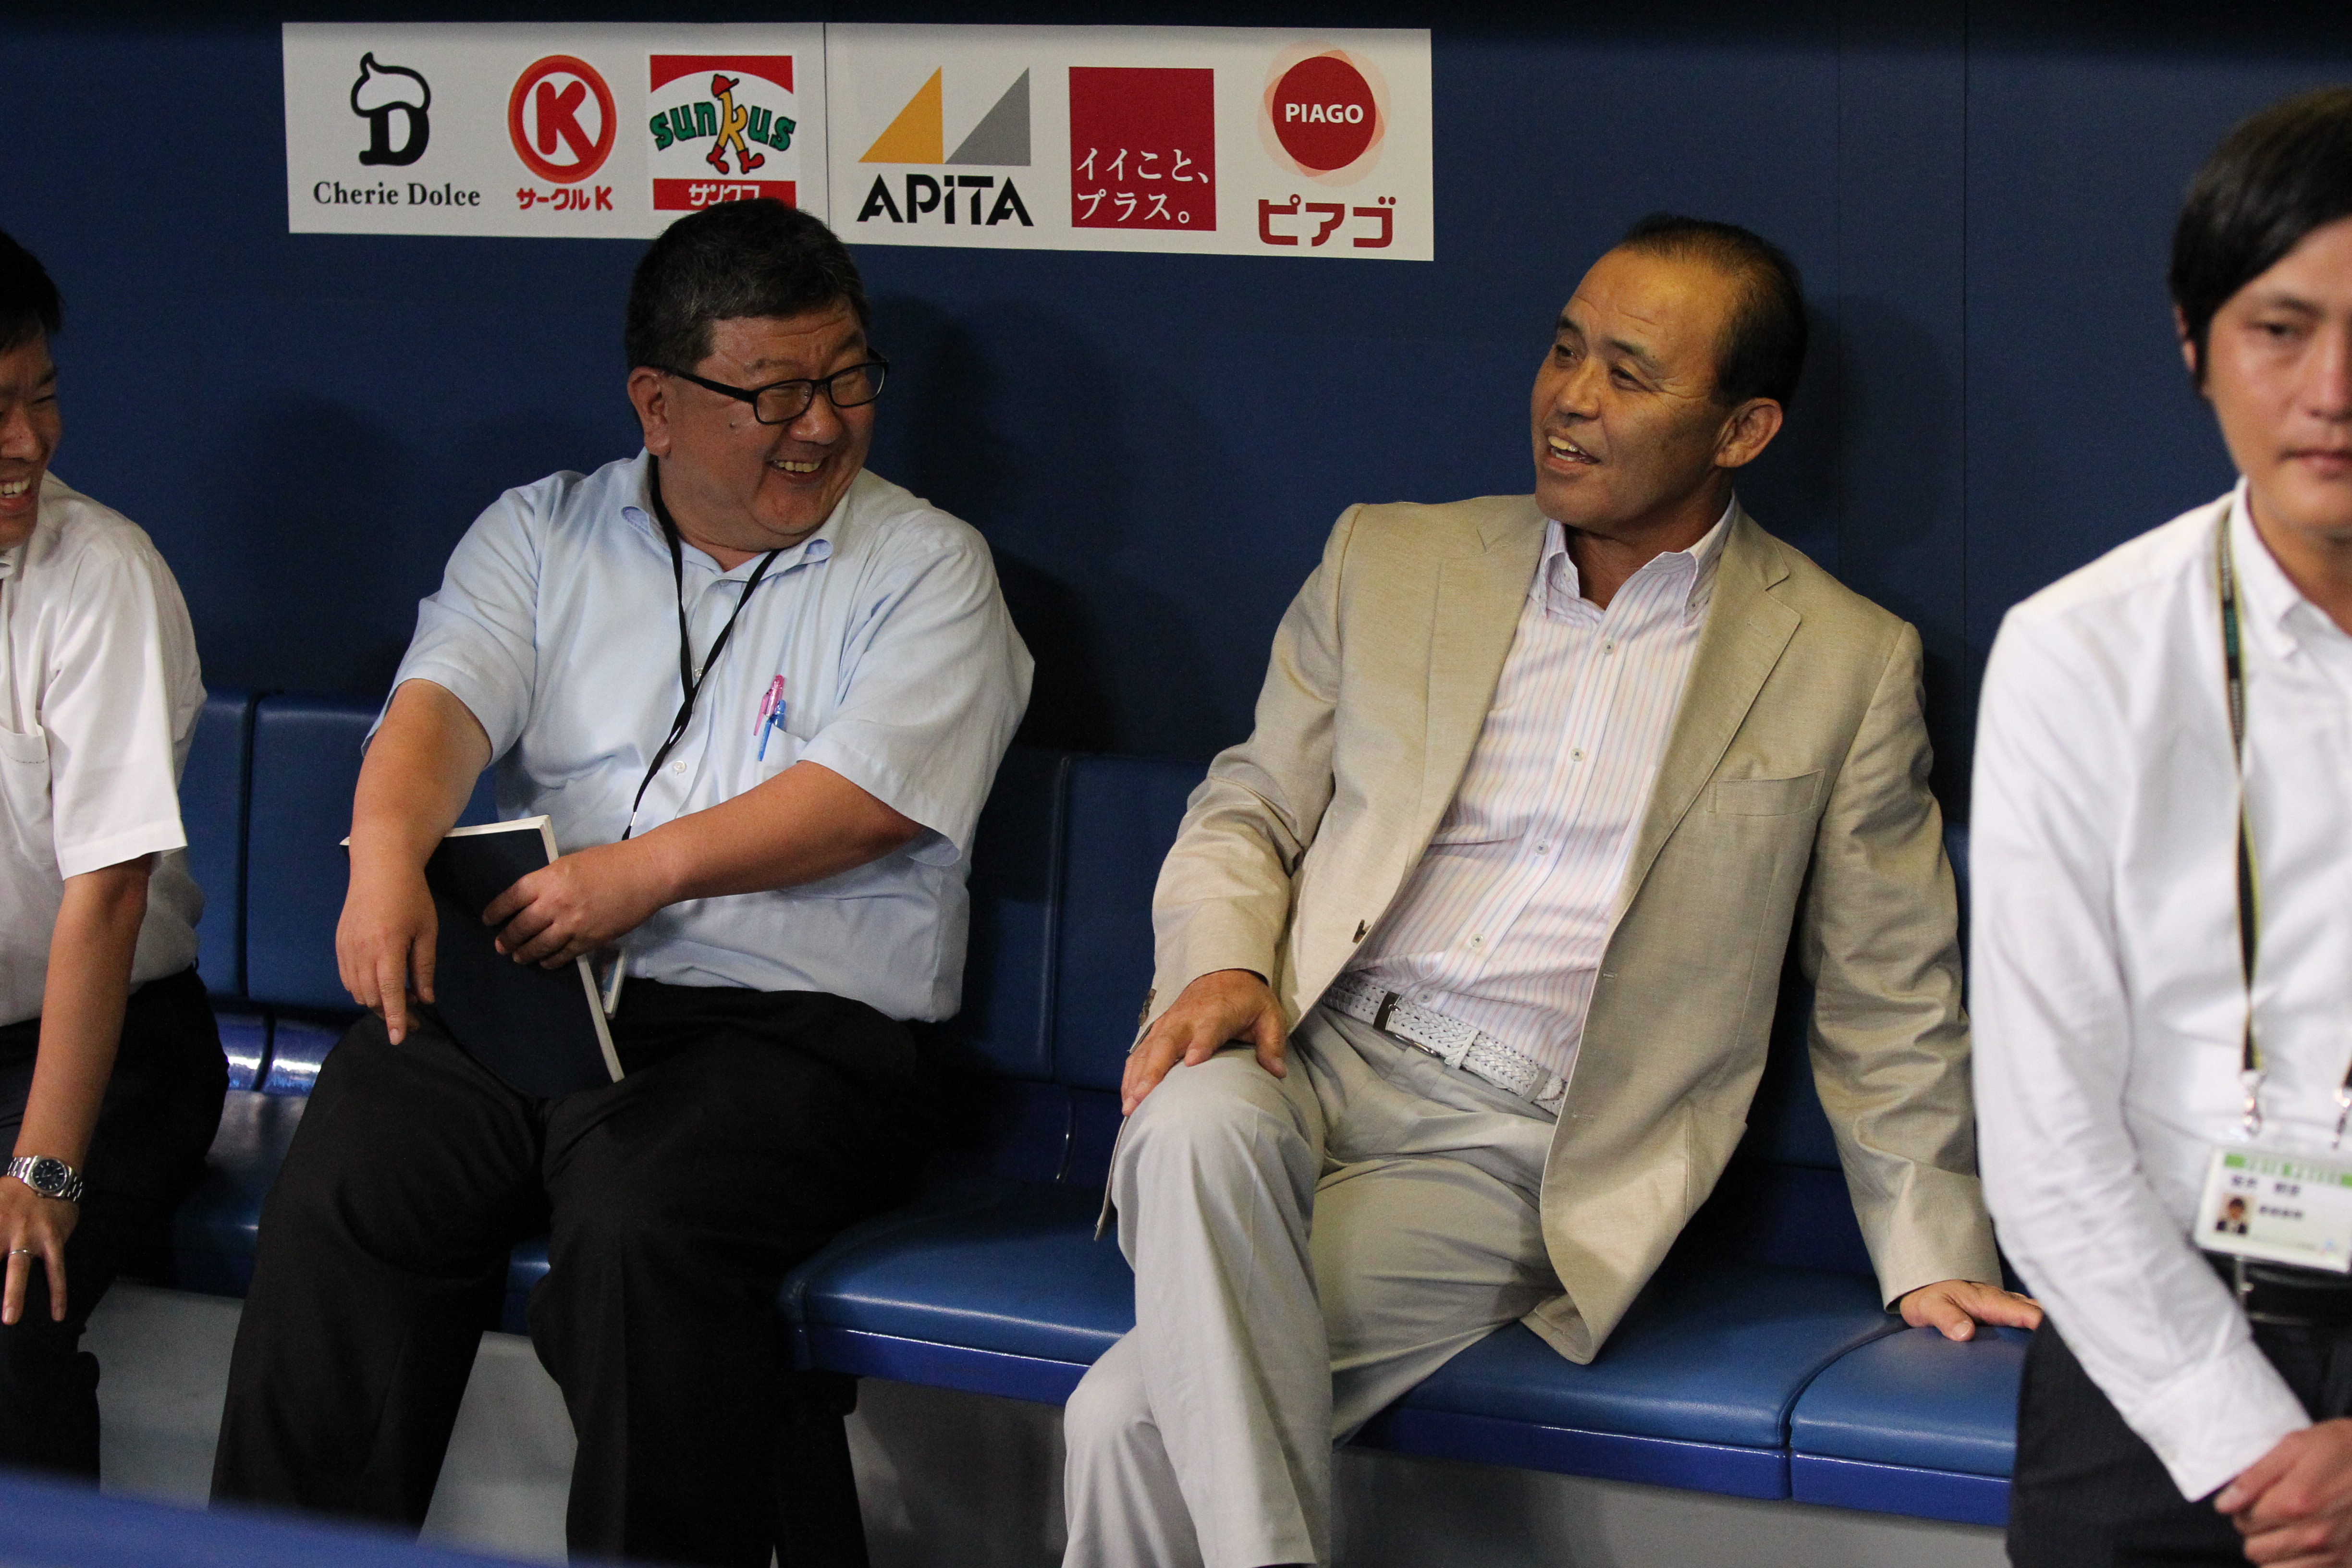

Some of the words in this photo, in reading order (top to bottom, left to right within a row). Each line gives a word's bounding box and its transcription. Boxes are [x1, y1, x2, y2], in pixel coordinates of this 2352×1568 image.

[536, 81, 596, 164] K
[1285, 103, 1363, 123] PIAGO
[1076, 147, 1210, 184] イイこと、
[313, 181, 398, 205] Cherie
[407, 183, 480, 206] Dolce
[1077, 188, 1190, 224] プラス。
[1258, 194, 1396, 248] ピアゴ
